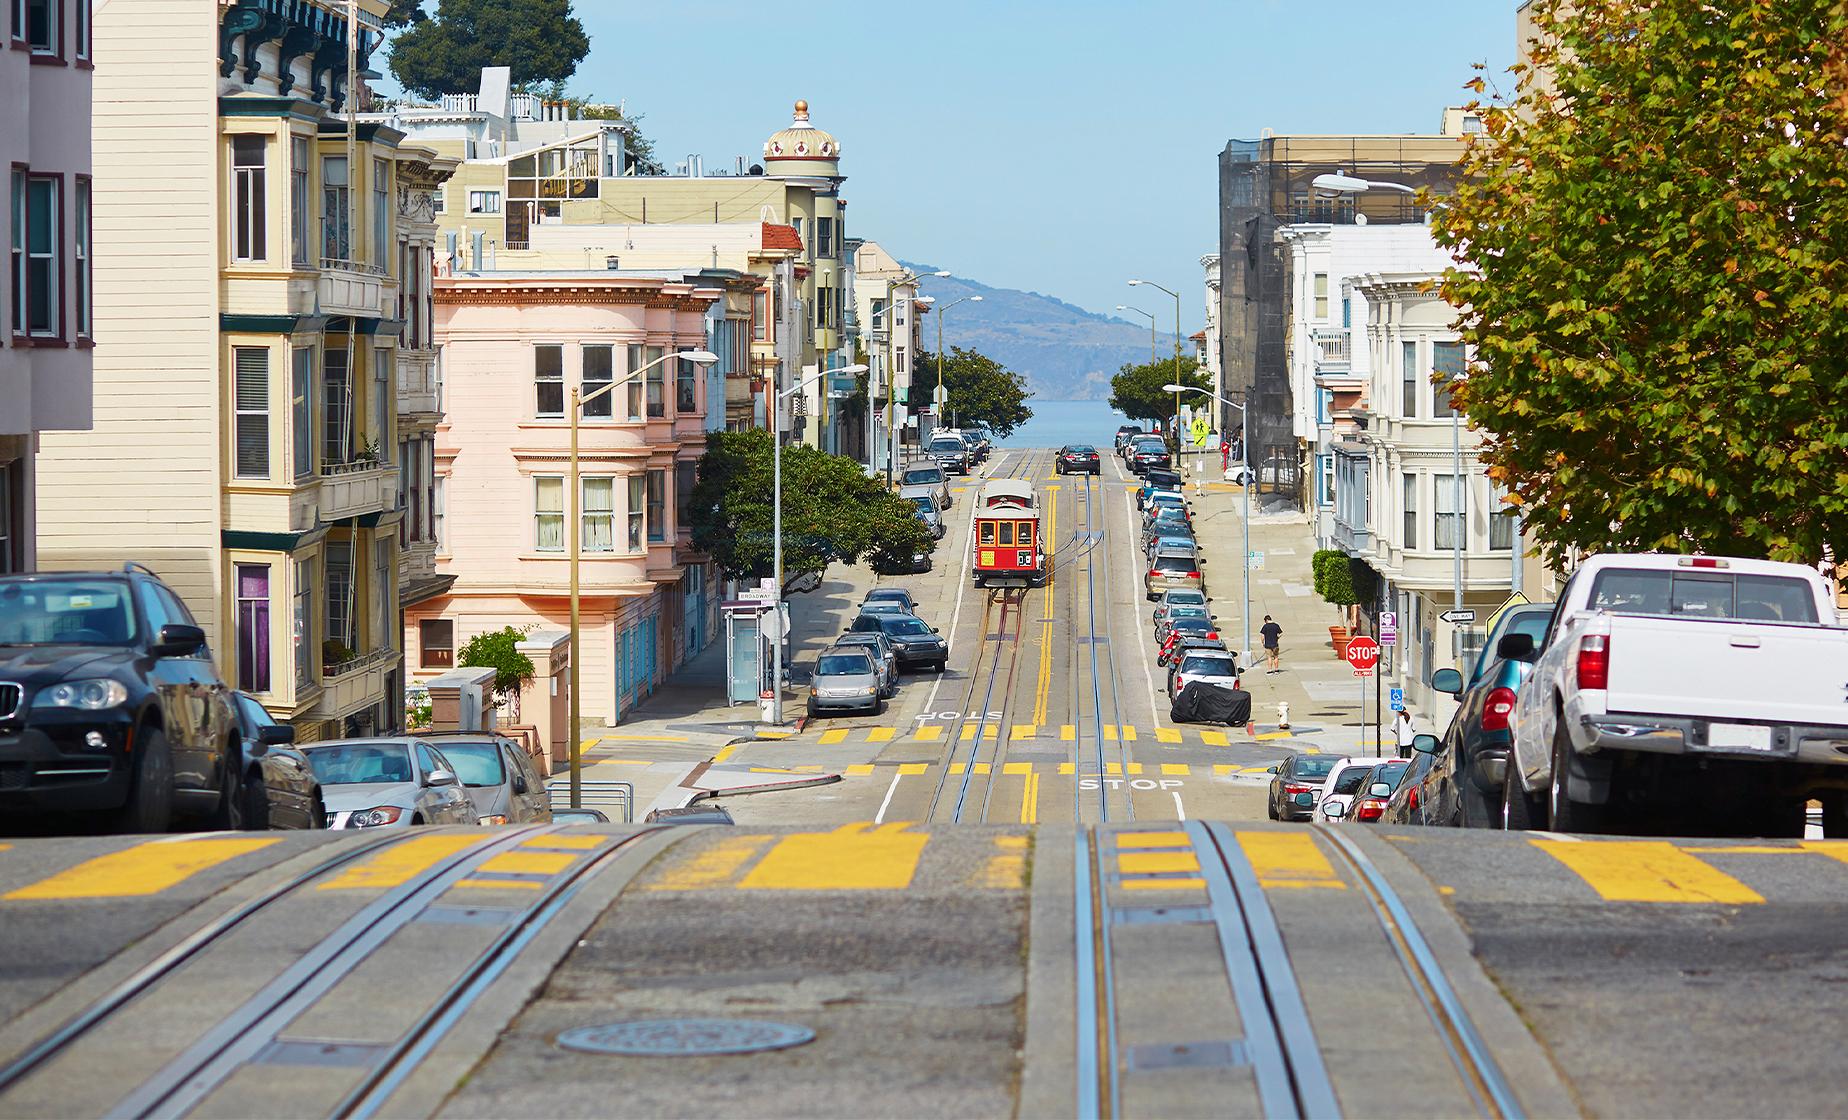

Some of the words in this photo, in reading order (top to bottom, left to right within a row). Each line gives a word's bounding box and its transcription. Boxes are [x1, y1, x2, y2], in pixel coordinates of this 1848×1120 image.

[1349, 647, 1377, 659] STOP
[915, 711, 1002, 720] STOP
[1079, 779, 1184, 790] STOP
